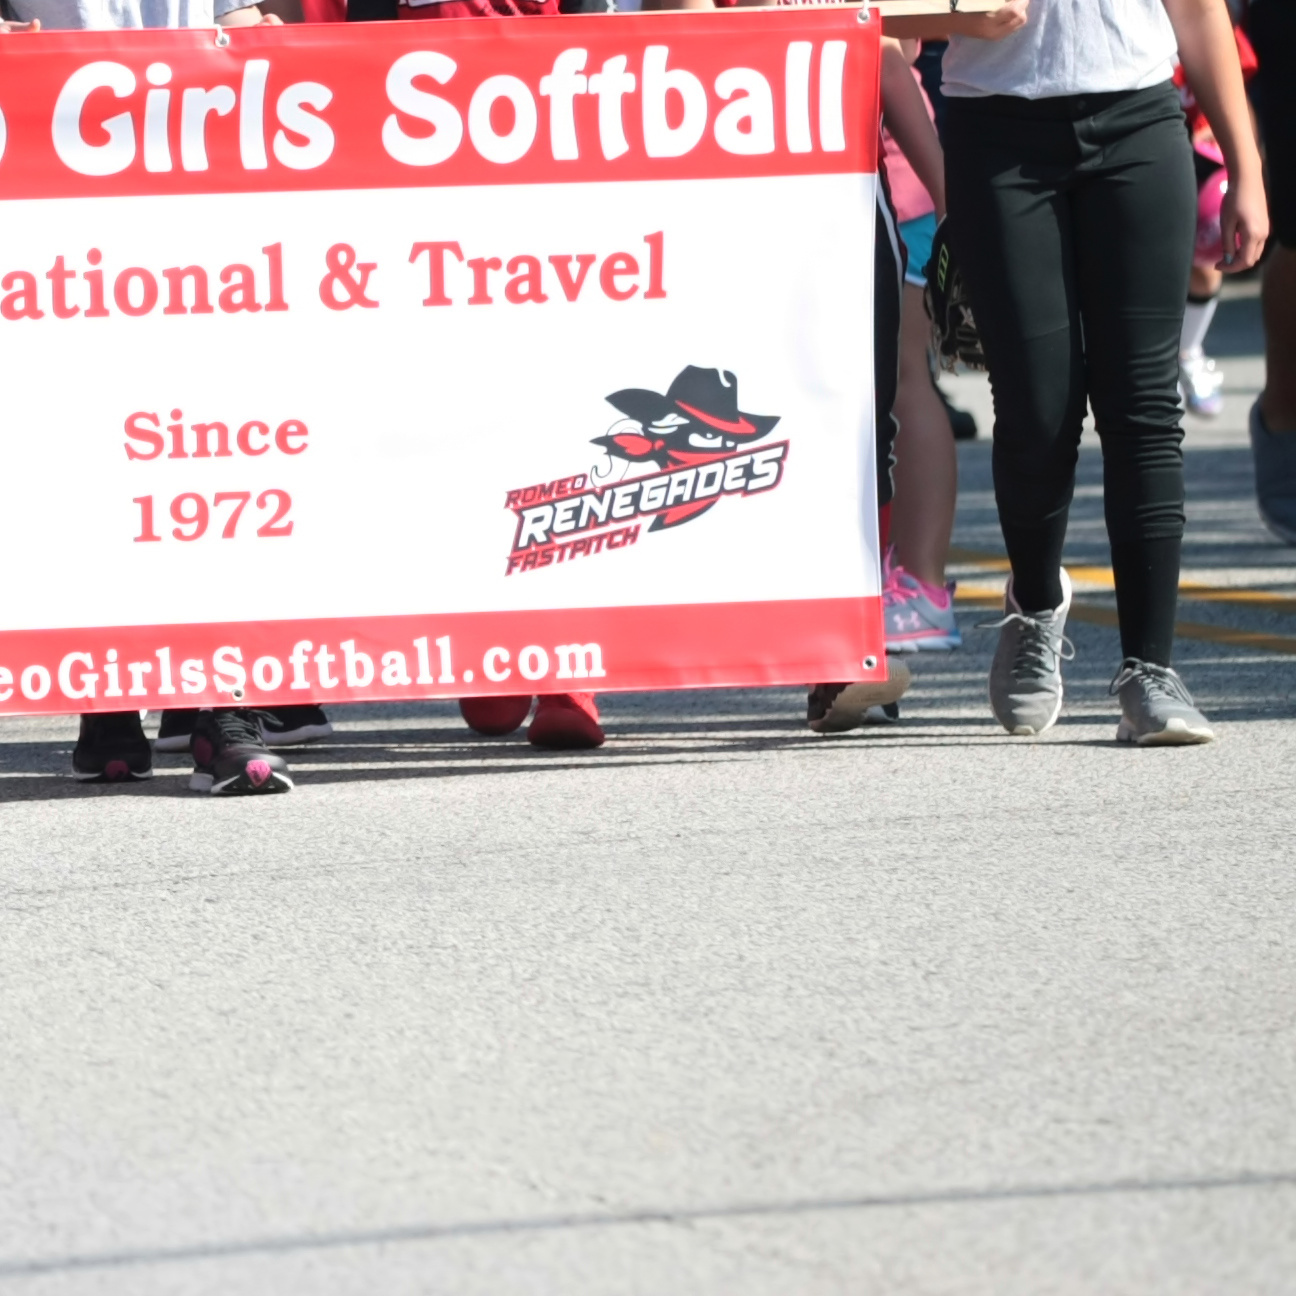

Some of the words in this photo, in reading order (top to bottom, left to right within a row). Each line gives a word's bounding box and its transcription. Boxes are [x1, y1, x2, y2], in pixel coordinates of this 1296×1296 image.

[51, 58, 336, 178] Girls
[381, 39, 848, 167] Softball
[318, 242, 380, 309] &
[408, 230, 667, 307] Travel
[123, 407, 309, 461] Since
[132, 488, 295, 542] 1972
[504, 472, 588, 509] ROMEO
[514, 441, 788, 550] RENEGADES
[504, 524, 641, 577] FASTPITCH
